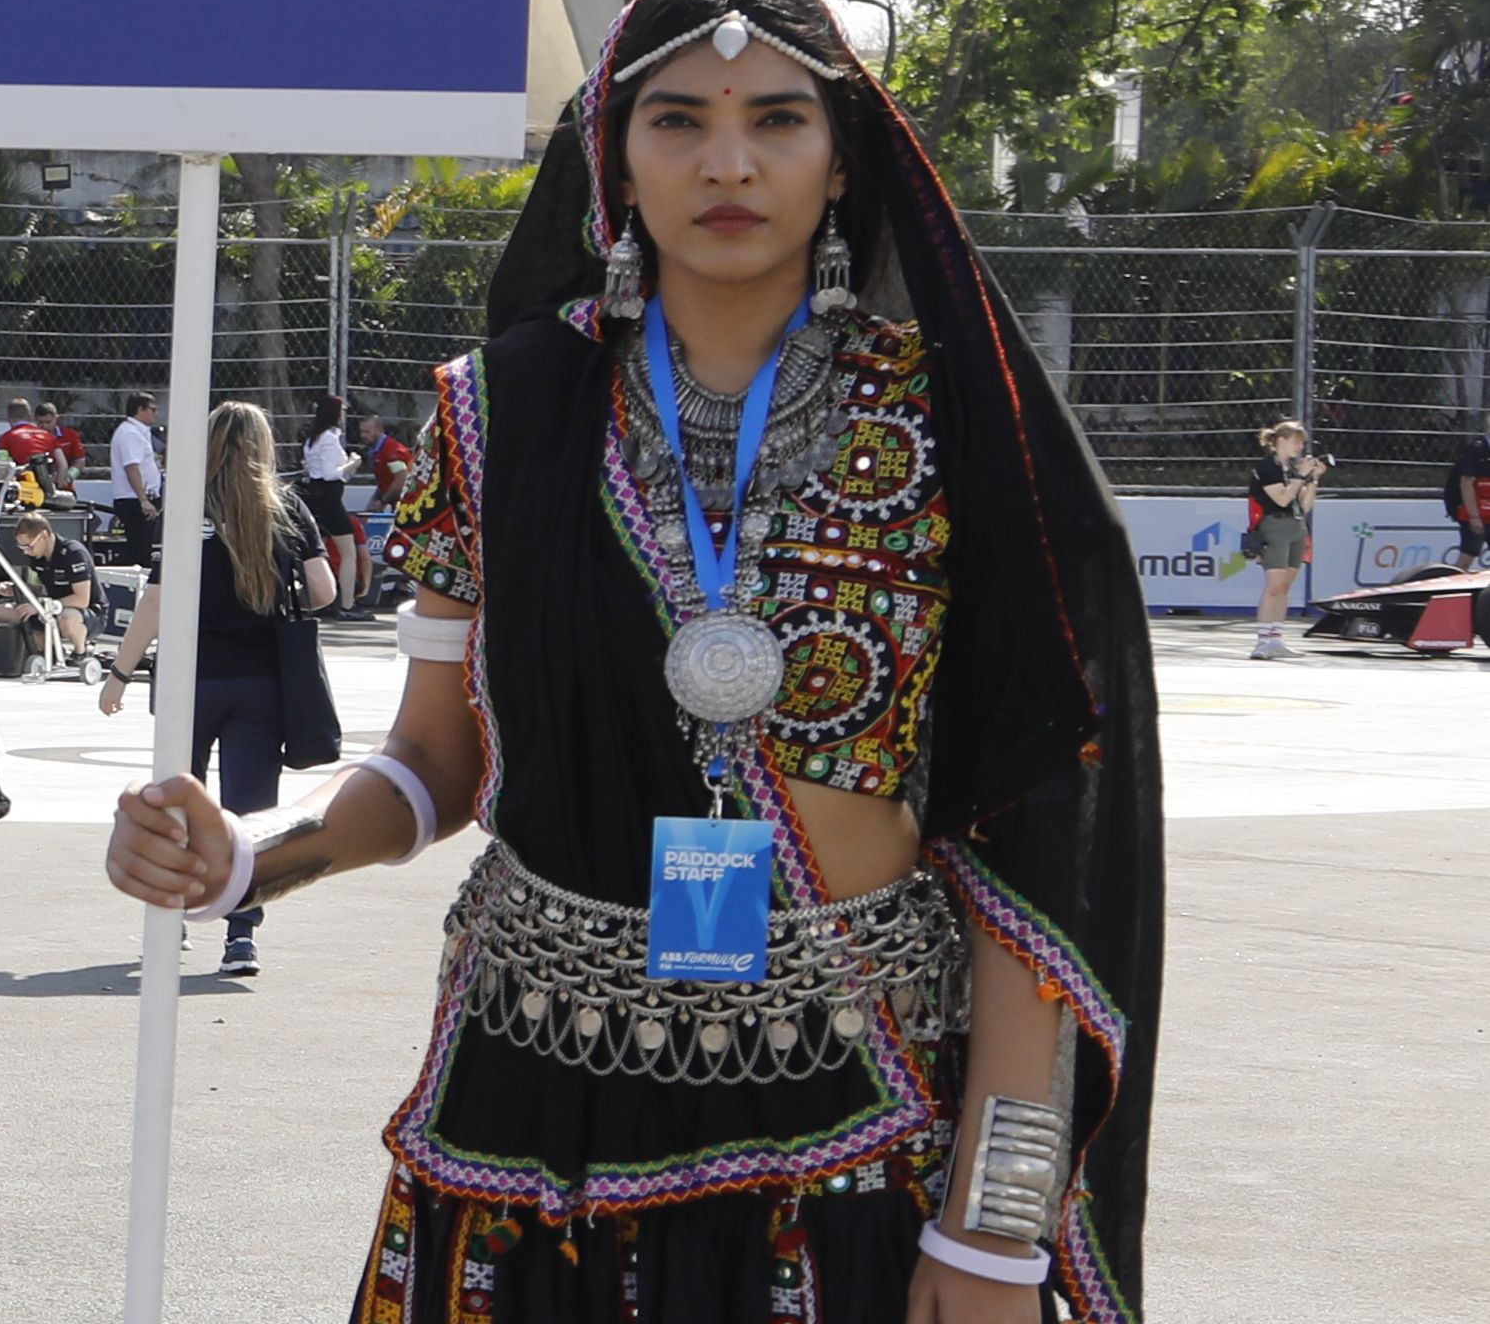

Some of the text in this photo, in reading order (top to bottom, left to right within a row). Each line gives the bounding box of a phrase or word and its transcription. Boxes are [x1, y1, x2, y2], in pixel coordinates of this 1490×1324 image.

[1138, 550, 1216, 577] mda
[663, 850, 757, 869] PADDOCK
[663, 866, 725, 882] STAFF
